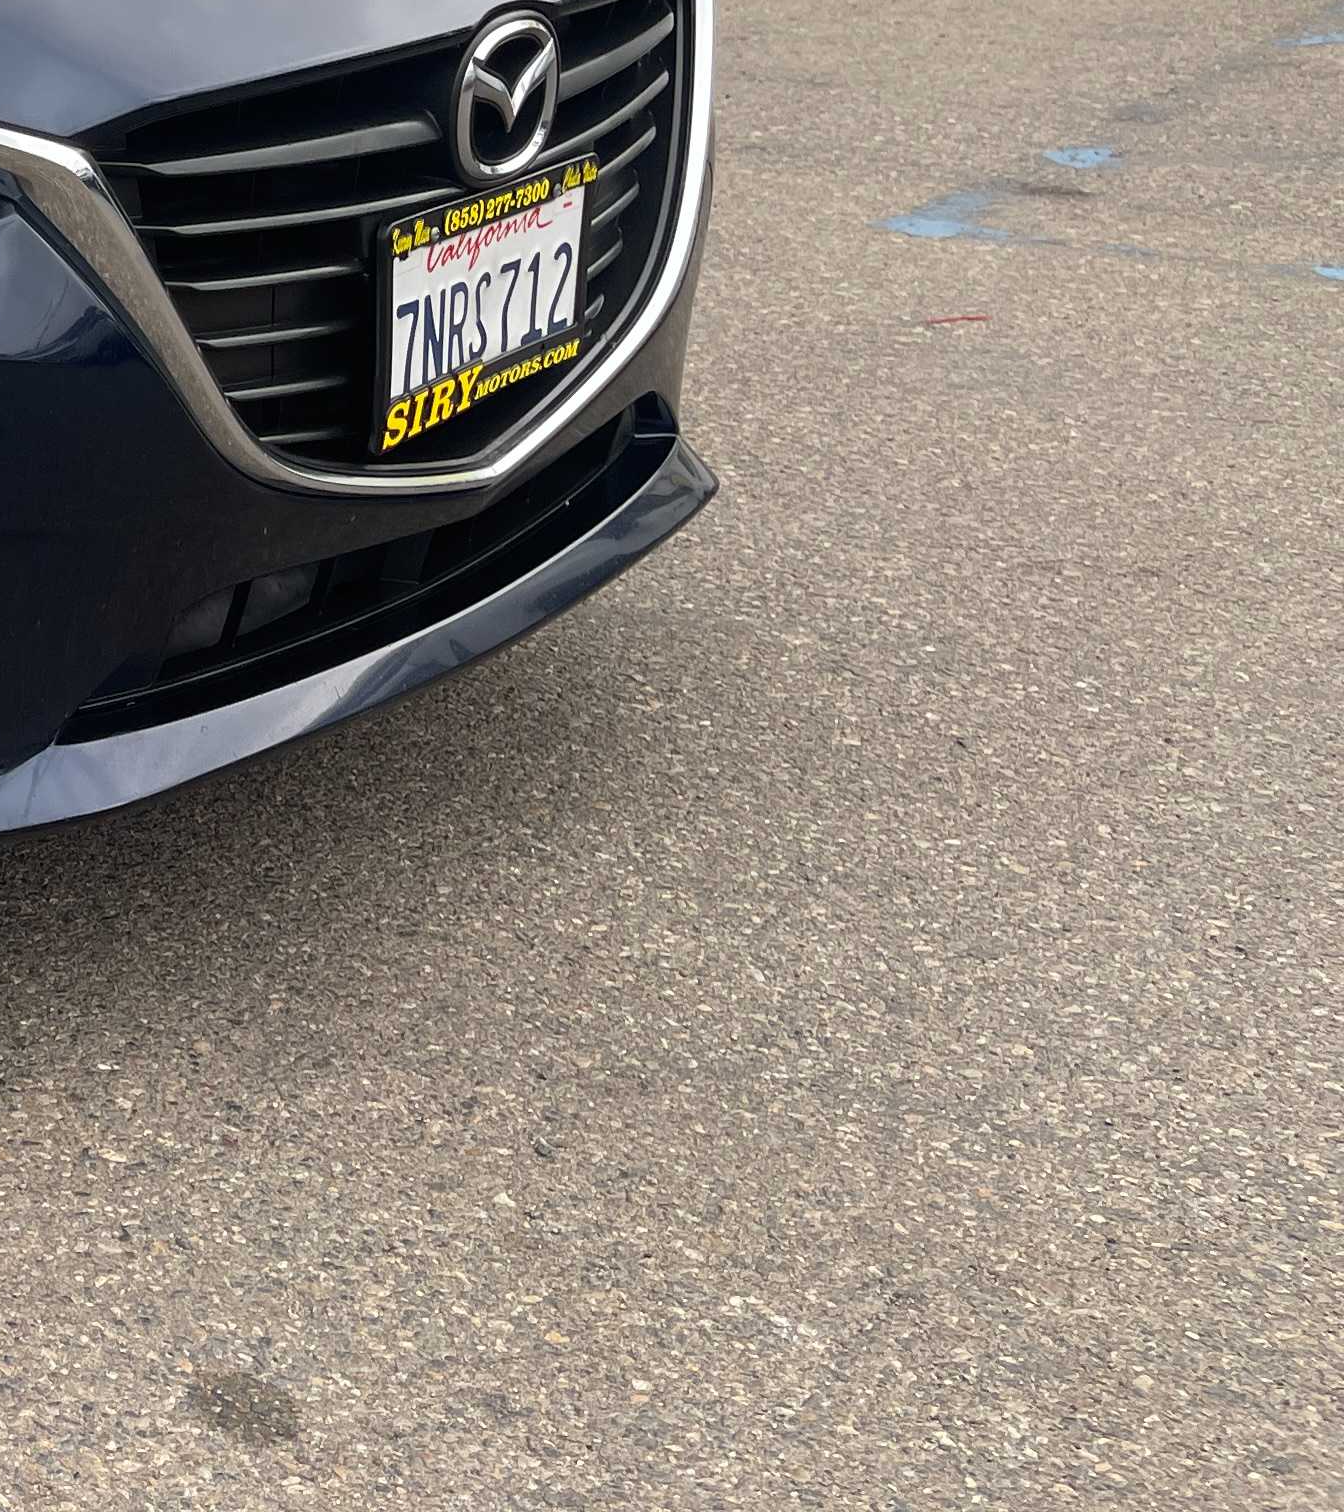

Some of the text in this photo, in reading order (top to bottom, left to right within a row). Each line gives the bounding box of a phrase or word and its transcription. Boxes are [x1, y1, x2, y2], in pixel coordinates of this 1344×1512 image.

[426, 206, 553, 272] California
[444, 197, 485, 236] (858)
[486, 177, 550, 220] 277-7300
[396, 241, 573, 397] 7NRS712
[382, 338, 580, 451] SIRY MOTORS.COM
